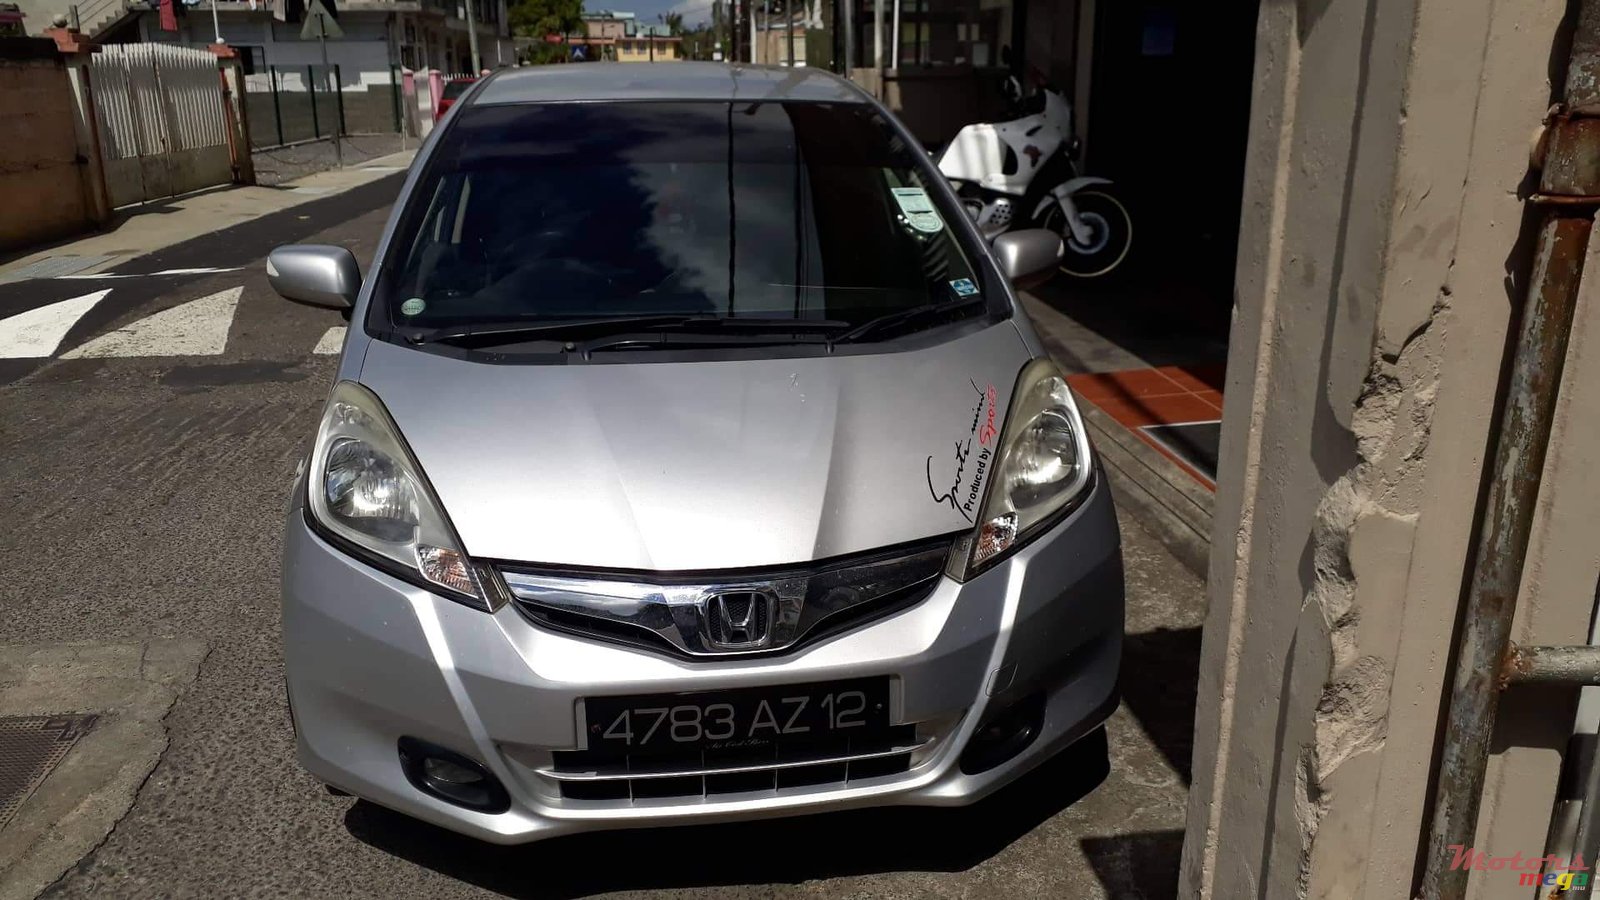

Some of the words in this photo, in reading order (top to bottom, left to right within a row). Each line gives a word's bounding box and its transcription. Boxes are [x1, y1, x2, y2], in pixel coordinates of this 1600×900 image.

[970, 377, 985, 434] mind
[979, 383, 997, 446] Sports
[979, 447, 992, 460] by
[963, 460, 986, 512] Produced
[603, 703, 735, 745] 4783
[748, 696, 811, 737] AZ
[821, 691, 867, 729] 12
